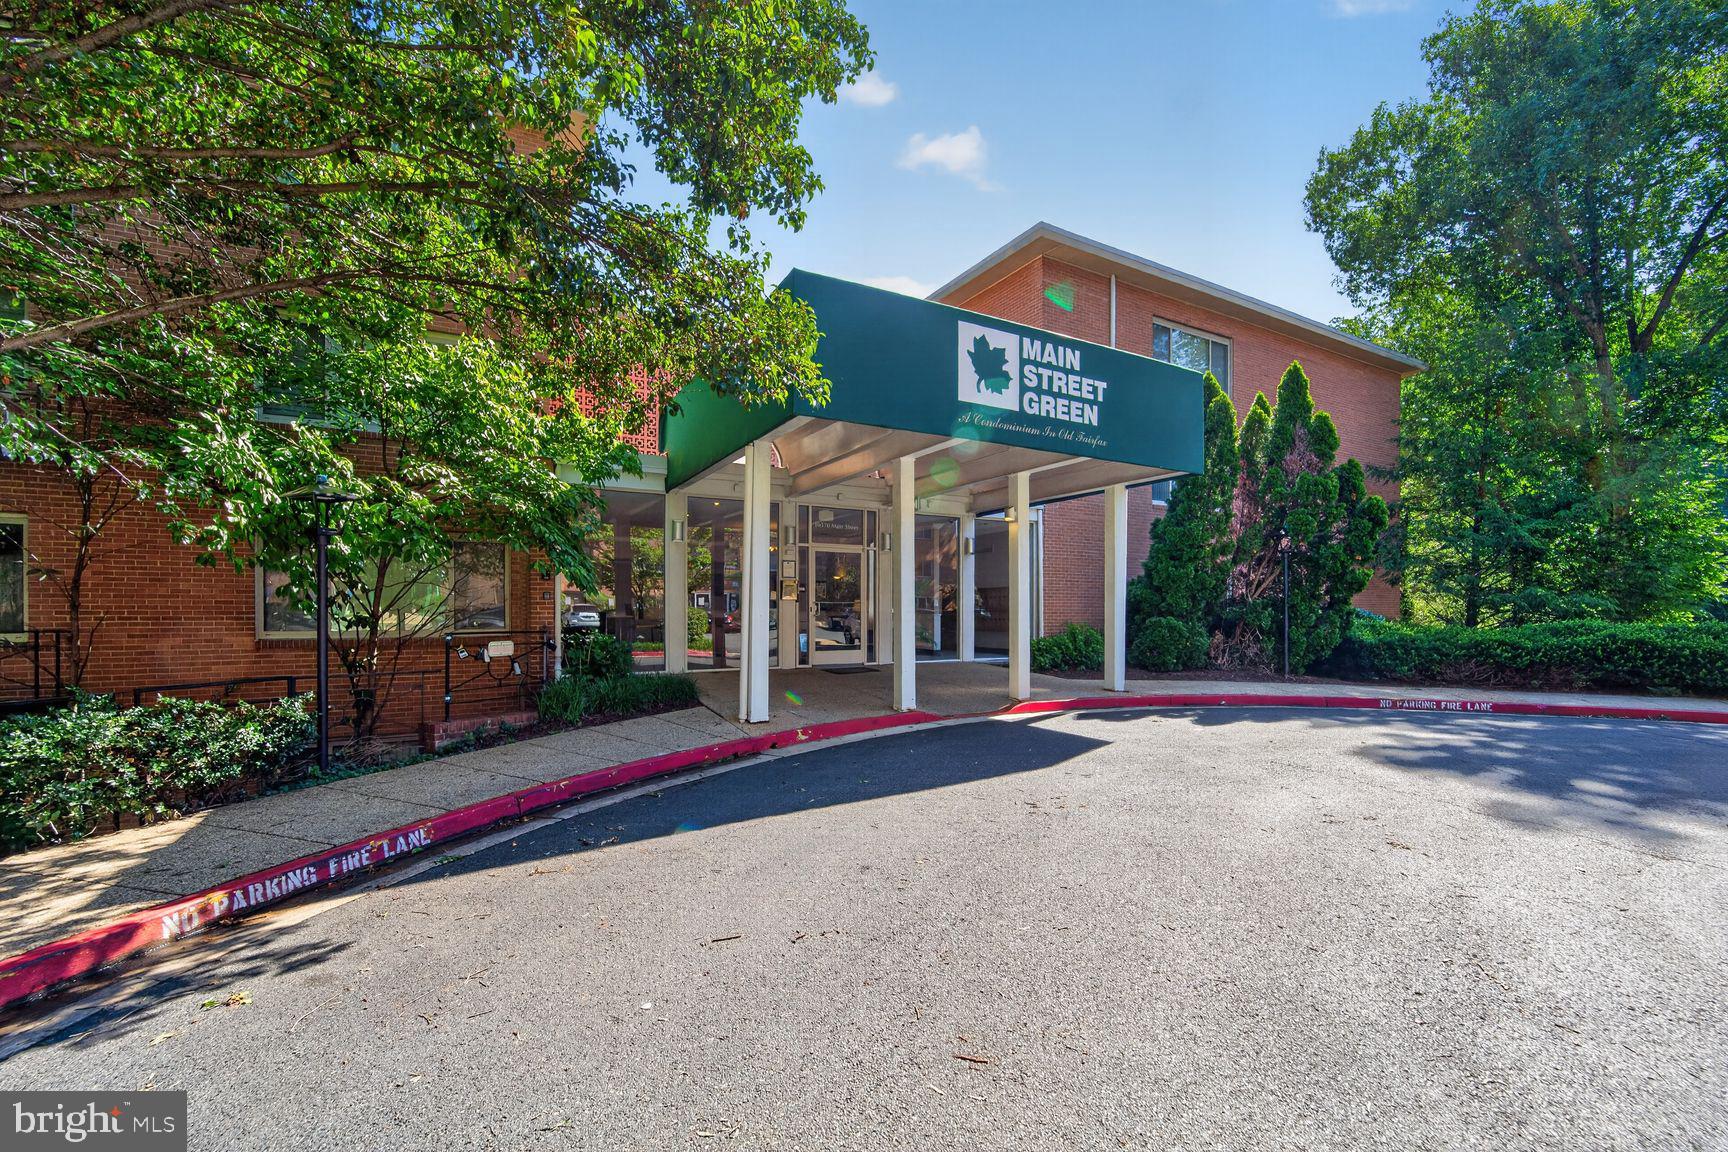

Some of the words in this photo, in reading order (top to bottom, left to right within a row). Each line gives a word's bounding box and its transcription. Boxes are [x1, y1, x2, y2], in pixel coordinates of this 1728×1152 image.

[1022, 337, 1081, 371] MAIN
[1023, 364, 1107, 402] STREET
[1022, 391, 1098, 426] GREEN
[958, 411, 972, 424] A
[974, 412, 1041, 435] Condominium
[1042, 426, 1057, 437] In
[1058, 430, 1073, 441] Old
[1075, 431, 1108, 448] Fairfax
[1380, 699, 1392, 708] NO
[1397, 700, 1436, 709] PARKING
[1441, 701, 1462, 710] FIRE
[1467, 703, 1493, 711] LANE
[161, 904, 201, 940] NO
[211, 866, 318, 917] PARKING
[329, 844, 372, 879] FIRE
